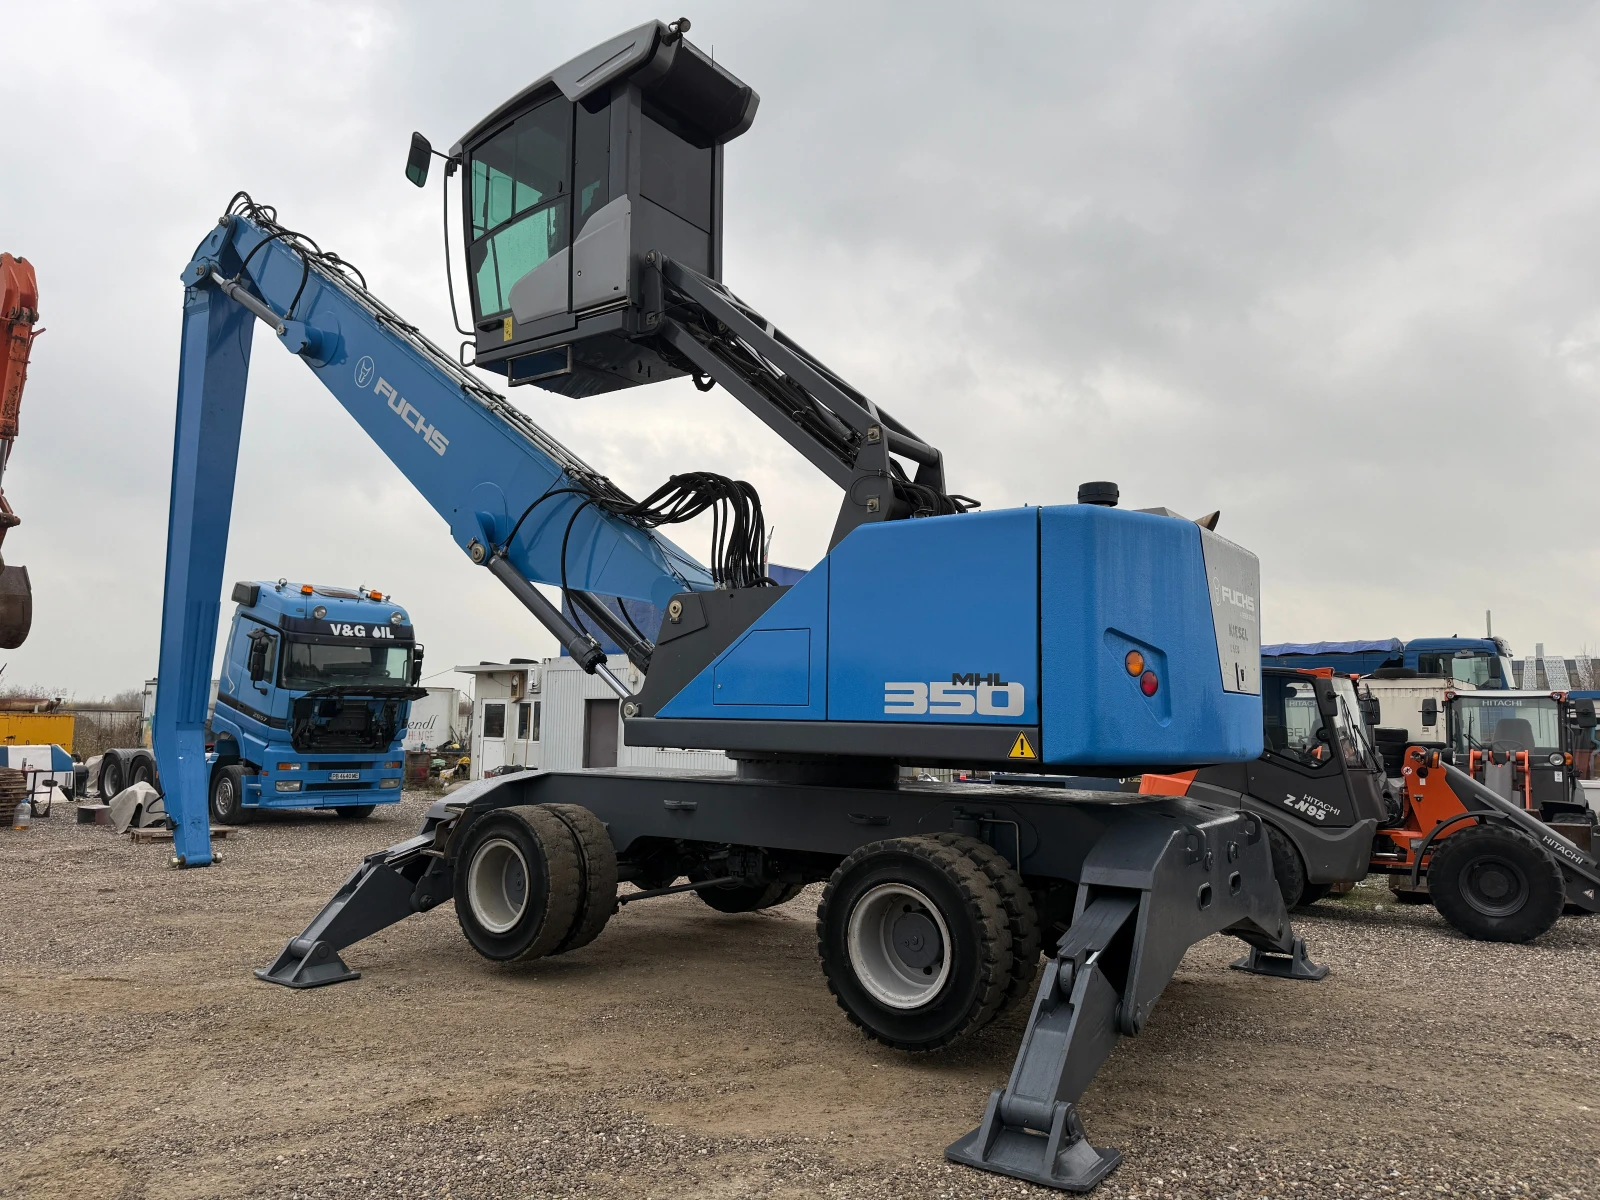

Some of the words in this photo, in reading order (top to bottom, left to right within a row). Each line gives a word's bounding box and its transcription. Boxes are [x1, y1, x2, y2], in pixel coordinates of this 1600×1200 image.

[373, 376, 450, 457] FUCHS
[1221, 585, 1255, 612] FUCHS
[330, 623, 366, 637] V&G
[952, 673, 1009, 687] MHL
[884, 682, 1025, 717] 350
[1303, 794, 1341, 816] HITACHI
[1542, 835, 1584, 864] HITACHI
